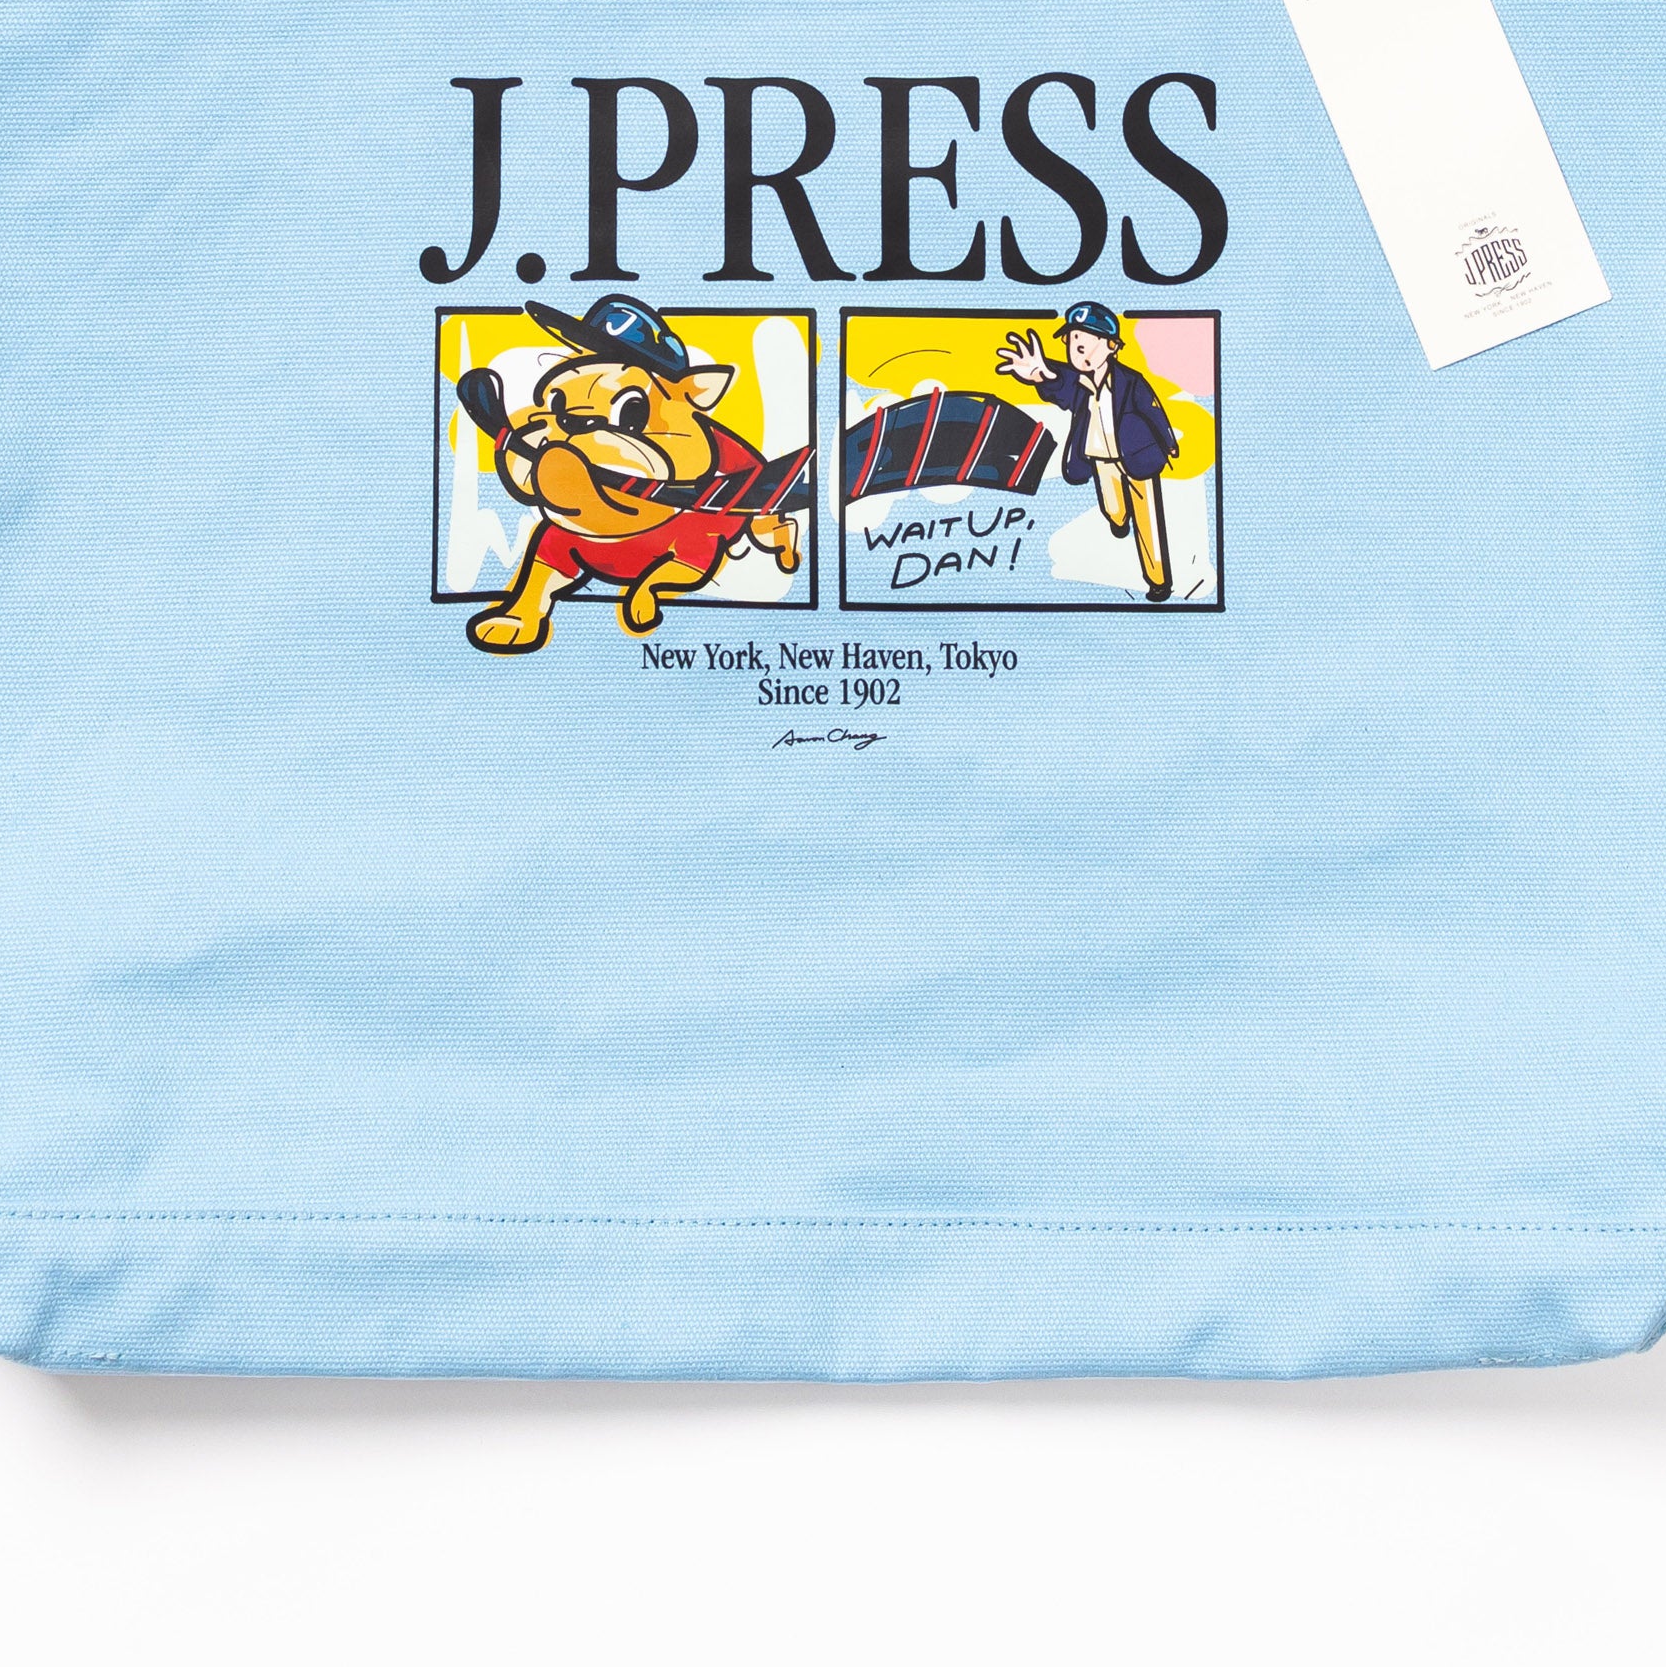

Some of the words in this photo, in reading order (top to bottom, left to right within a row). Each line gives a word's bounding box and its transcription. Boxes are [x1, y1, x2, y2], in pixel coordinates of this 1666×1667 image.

[419, 71, 1229, 286] J.PRESS
[1464, 238, 1528, 285] J.PRESS
[864, 516, 963, 551] WAIT
[641, 643, 697, 670] New
[703, 640, 771, 676] York,
[779, 642, 835, 670] New
[841, 642, 932, 676] Haven,
[939, 641, 1018, 679] Tokyo
[758, 678, 829, 706] Since
[840, 678, 901, 710] 1902
